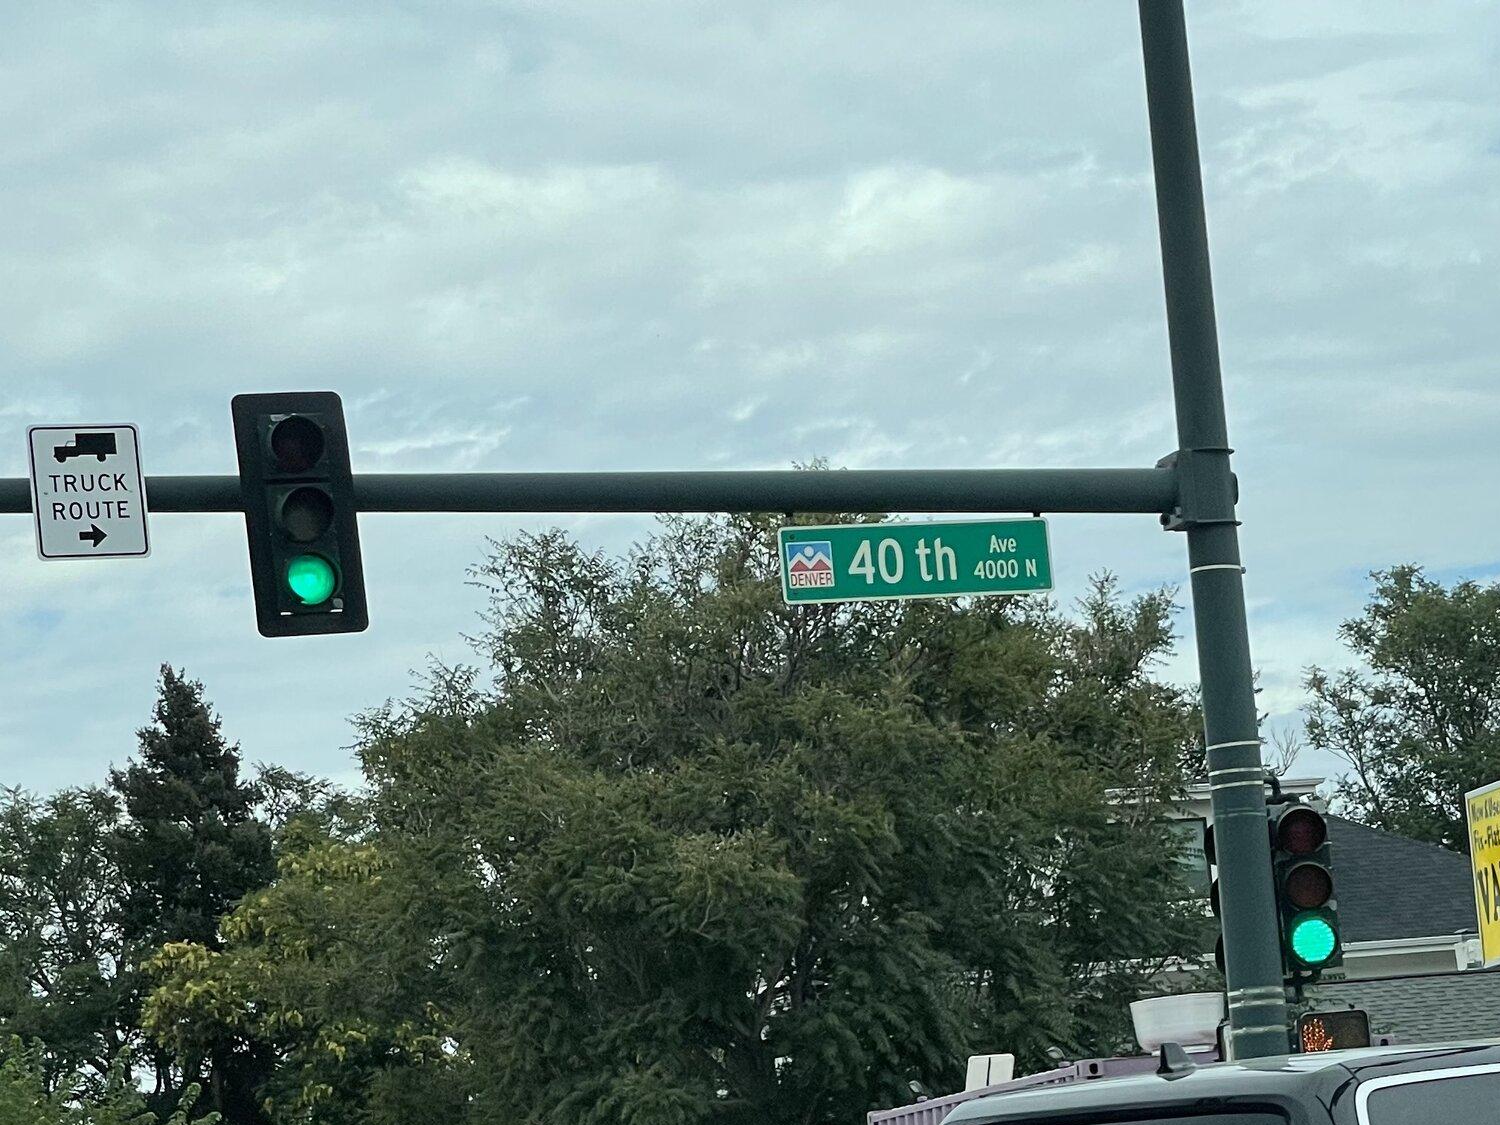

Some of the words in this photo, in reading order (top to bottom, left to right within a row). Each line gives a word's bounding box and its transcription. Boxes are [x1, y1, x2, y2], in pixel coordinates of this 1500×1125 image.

[49, 473, 128, 493] TRUCK
[52, 500, 130, 520] ROUTE
[989, 534, 1017, 554] Ave
[848, 538, 904, 584] 40
[915, 537, 958, 582] th
[973, 559, 1018, 579] 4000
[1025, 558, 1038, 578] N
[791, 572, 834, 587] DENVER
